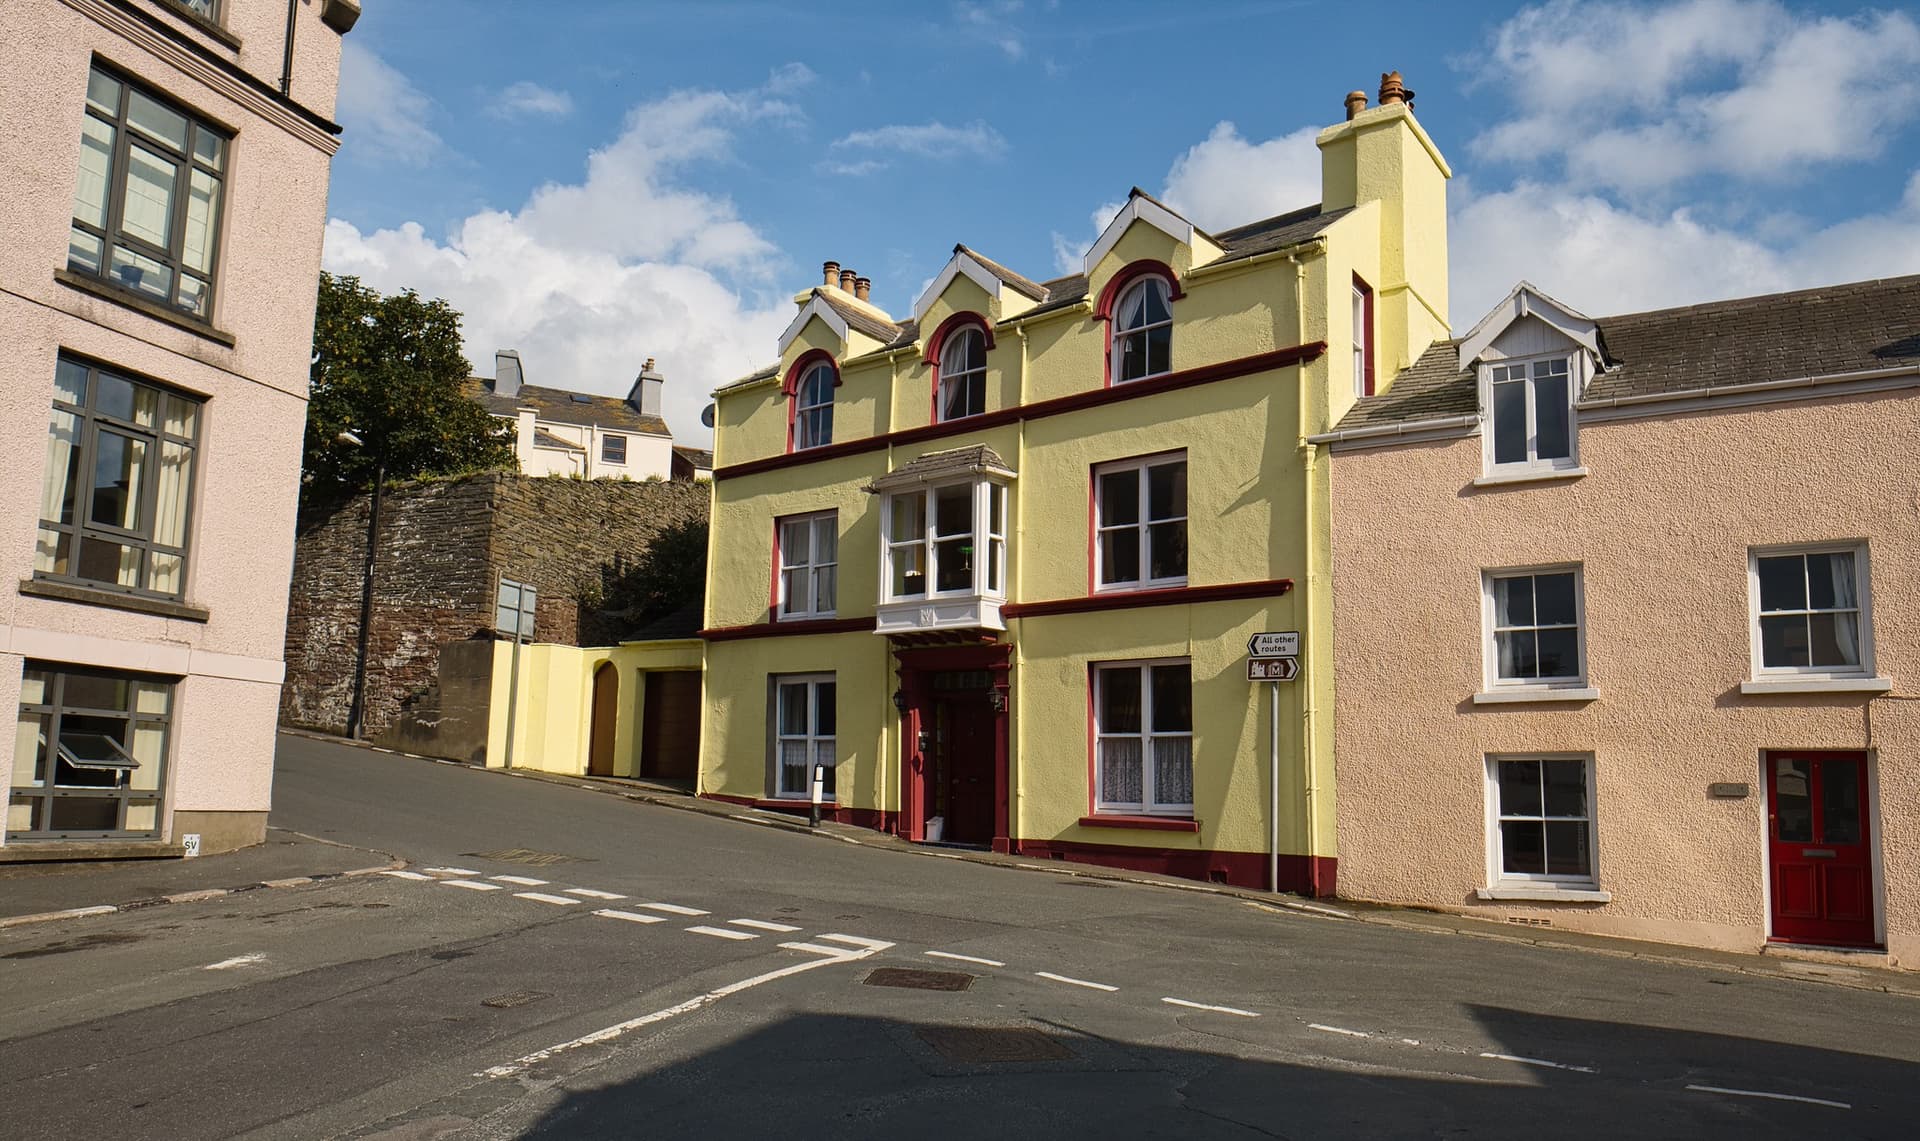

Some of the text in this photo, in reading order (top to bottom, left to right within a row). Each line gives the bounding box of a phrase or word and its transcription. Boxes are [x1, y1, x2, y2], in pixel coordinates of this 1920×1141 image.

[1262, 635, 1295, 644] All other
[185, 841, 197, 849] SV
